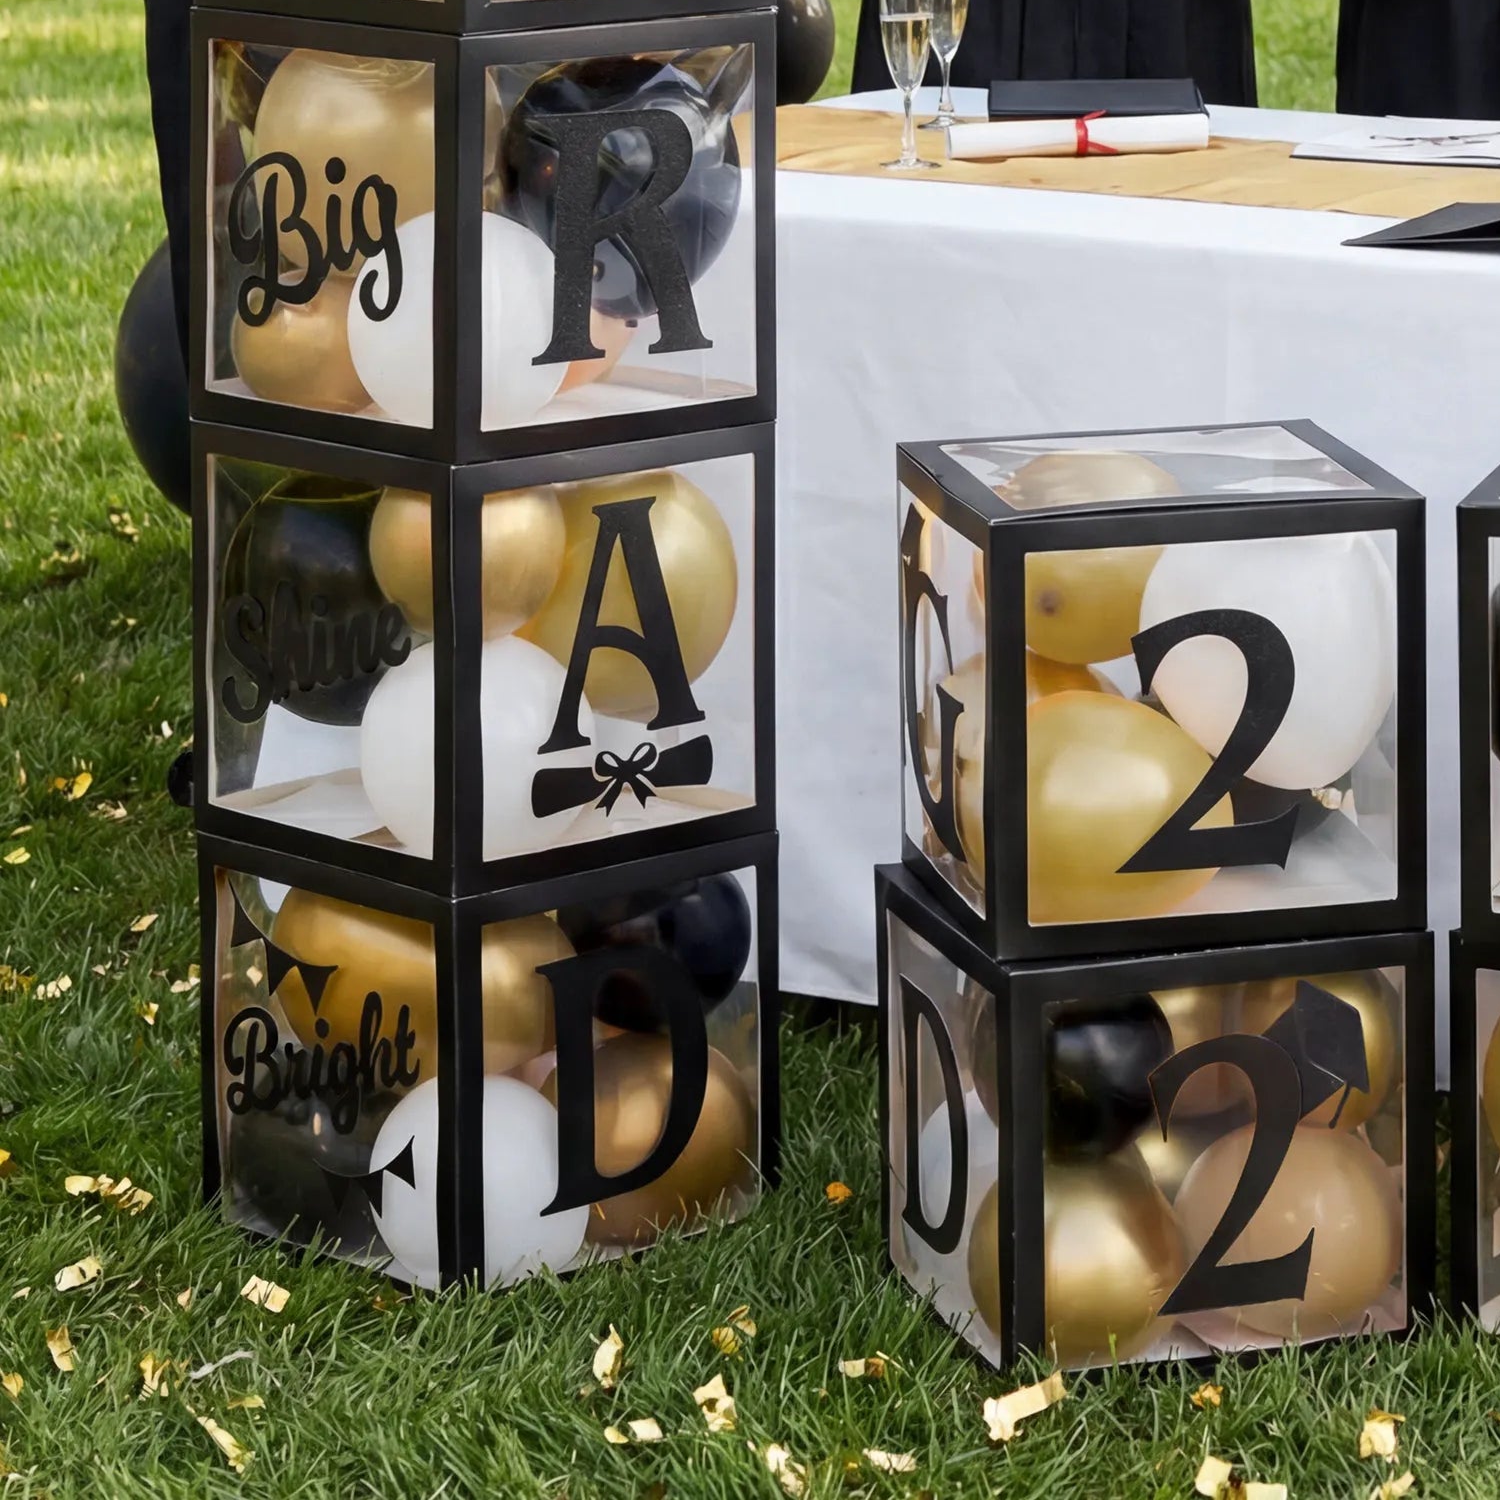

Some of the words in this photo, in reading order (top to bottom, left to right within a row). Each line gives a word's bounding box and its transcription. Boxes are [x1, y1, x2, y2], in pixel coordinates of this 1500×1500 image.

[228, 150, 402, 327] Big
[531, 108, 715, 367] R
[222, 579, 412, 723] Shine
[537, 496, 707, 755] A
[1116, 608, 1300, 874] 2
[224, 991, 421, 1135] Bright
[535, 949, 709, 1218] D
[899, 973, 969, 1256] D
[1149, 1032, 1315, 1317] 2
